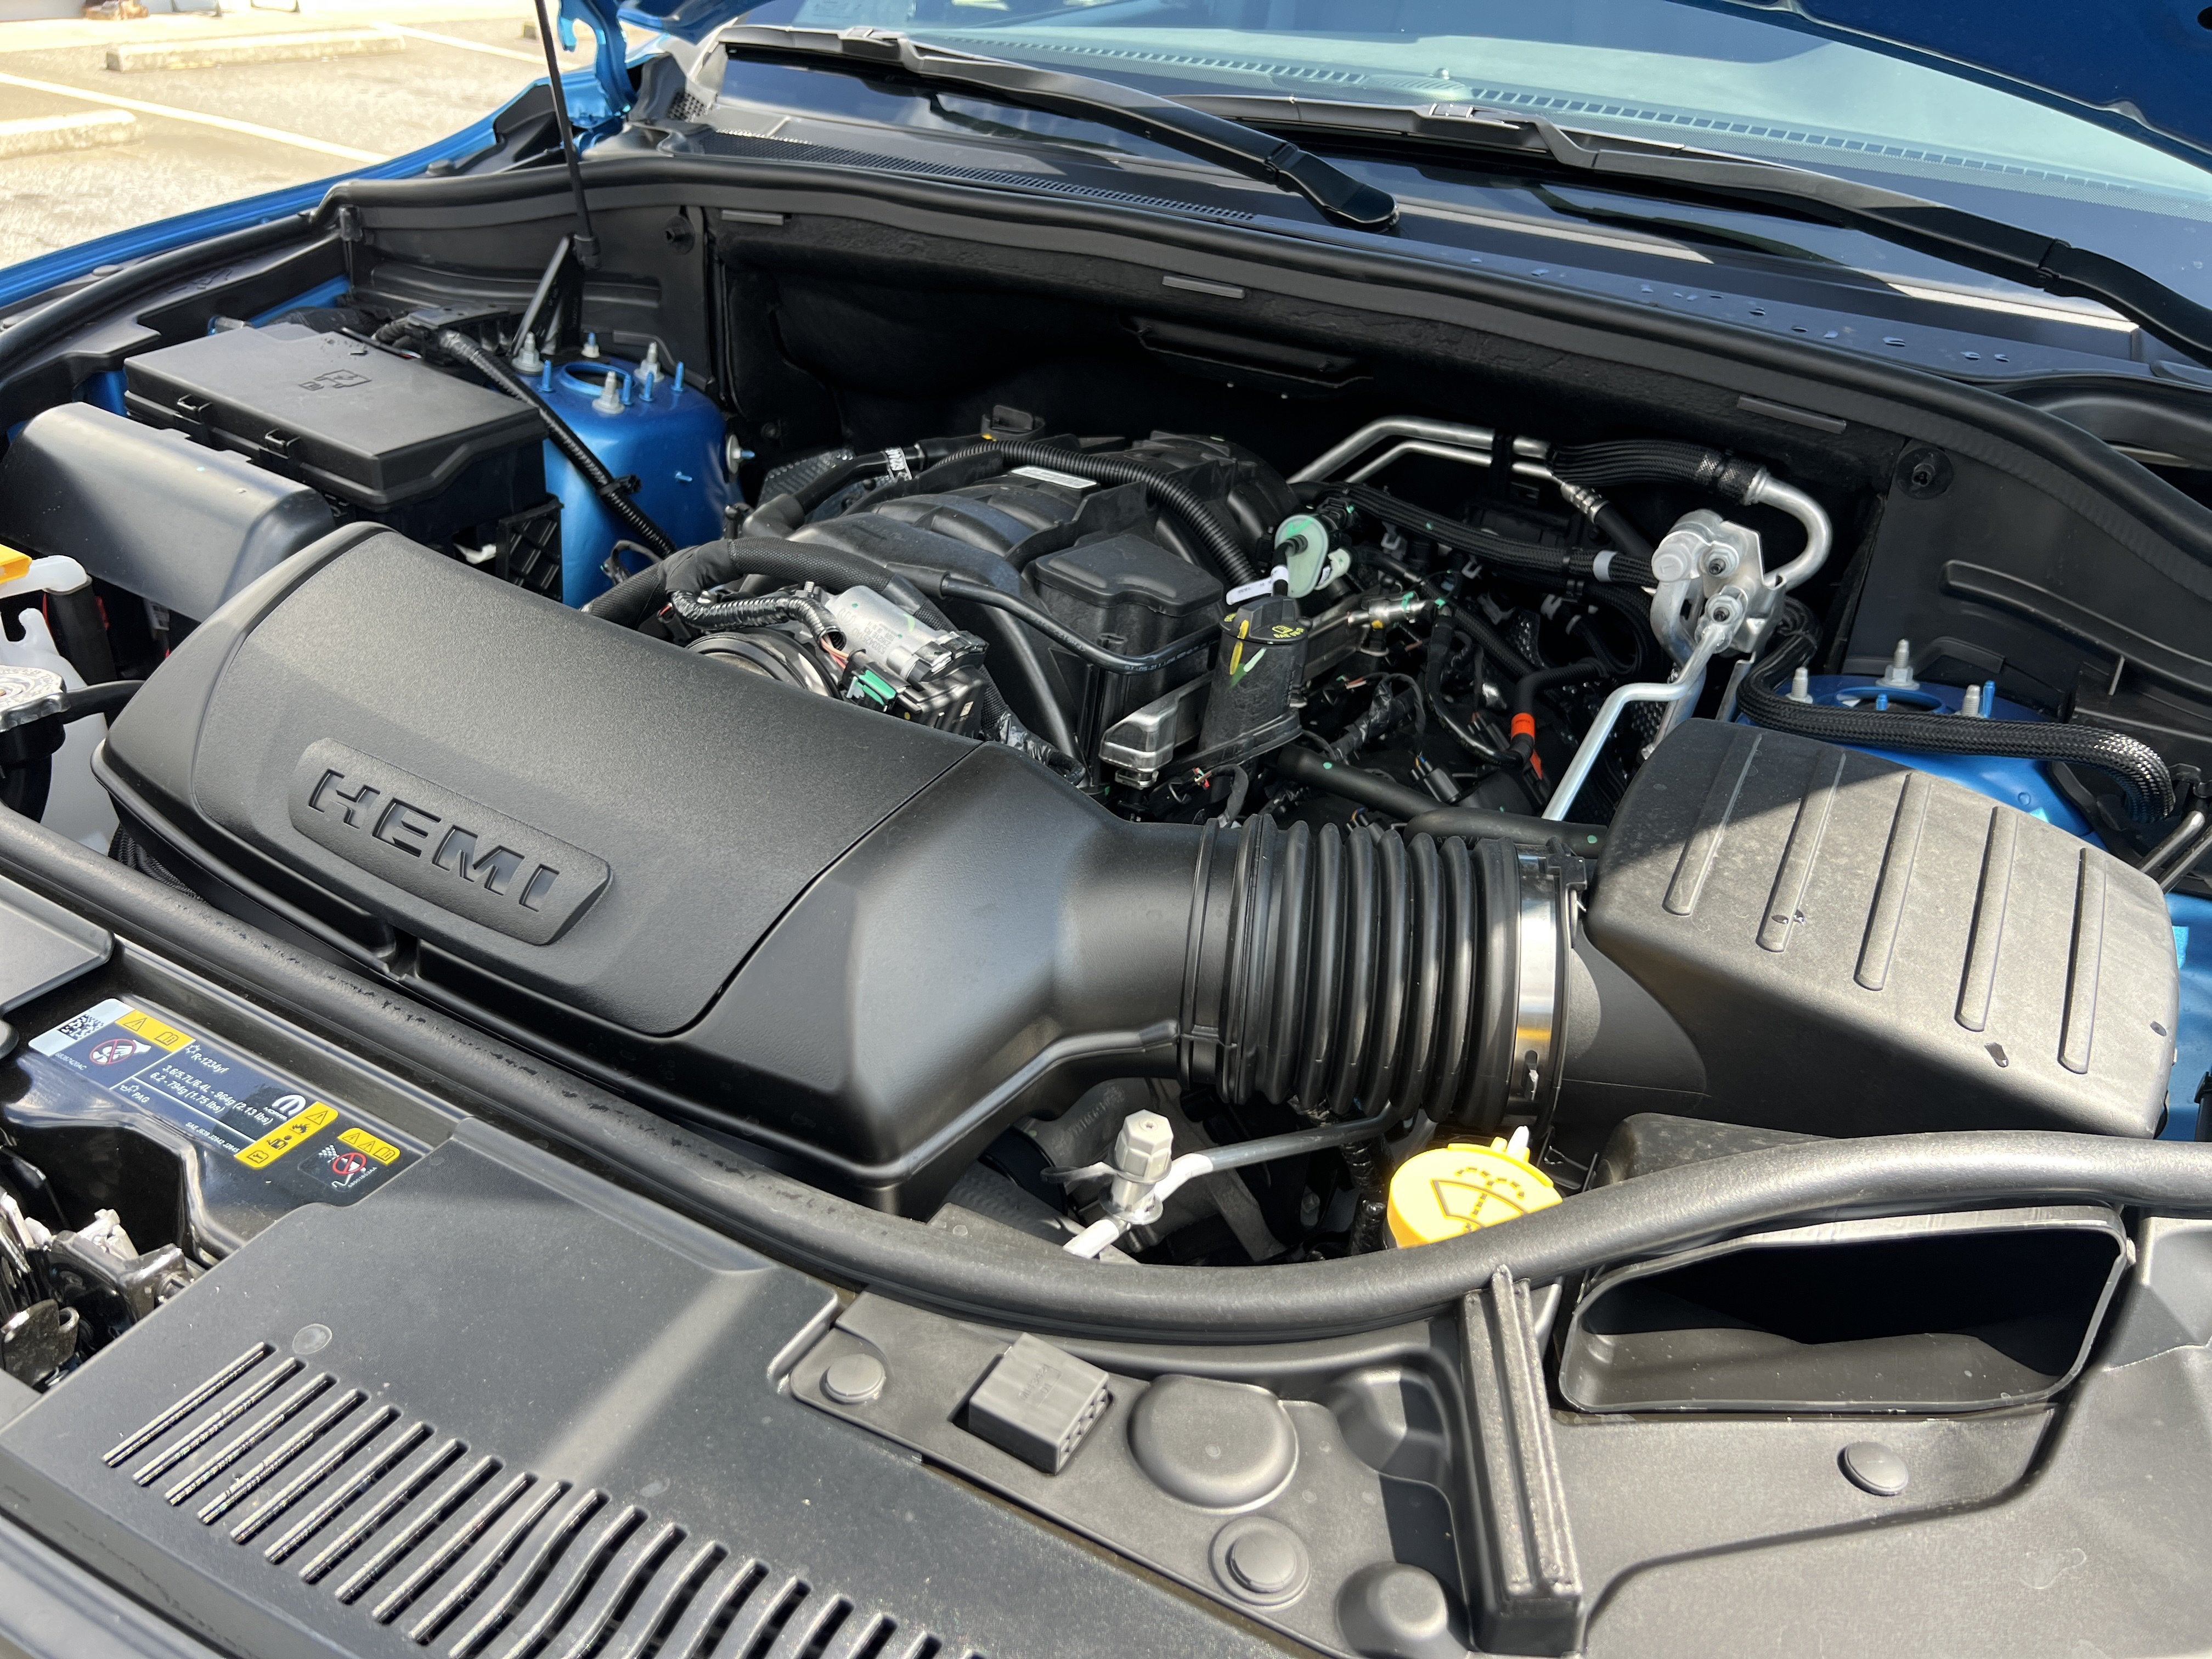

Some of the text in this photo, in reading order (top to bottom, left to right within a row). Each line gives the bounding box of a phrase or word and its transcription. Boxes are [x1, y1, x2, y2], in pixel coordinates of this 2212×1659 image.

[308, 768, 560, 912] HEMI
[191, 1053, 229, 1074] R-1234yf
[132, 1092, 150, 1103] PAG
[150, 1072, 166, 1082] 6.2
[167, 1080, 189, 1095] 794g
[185, 1091, 210, 1104] (1.75
[206, 1101, 225, 1113] lbs)
[162, 1065, 211, 1092] 3.6/5.7L/6.4L
[214, 1091, 236, 1106] 964g
[233, 1102, 257, 1115] (2.13
[254, 1112, 273, 1125] lbs)
[185, 1122, 199, 1130] SAE
